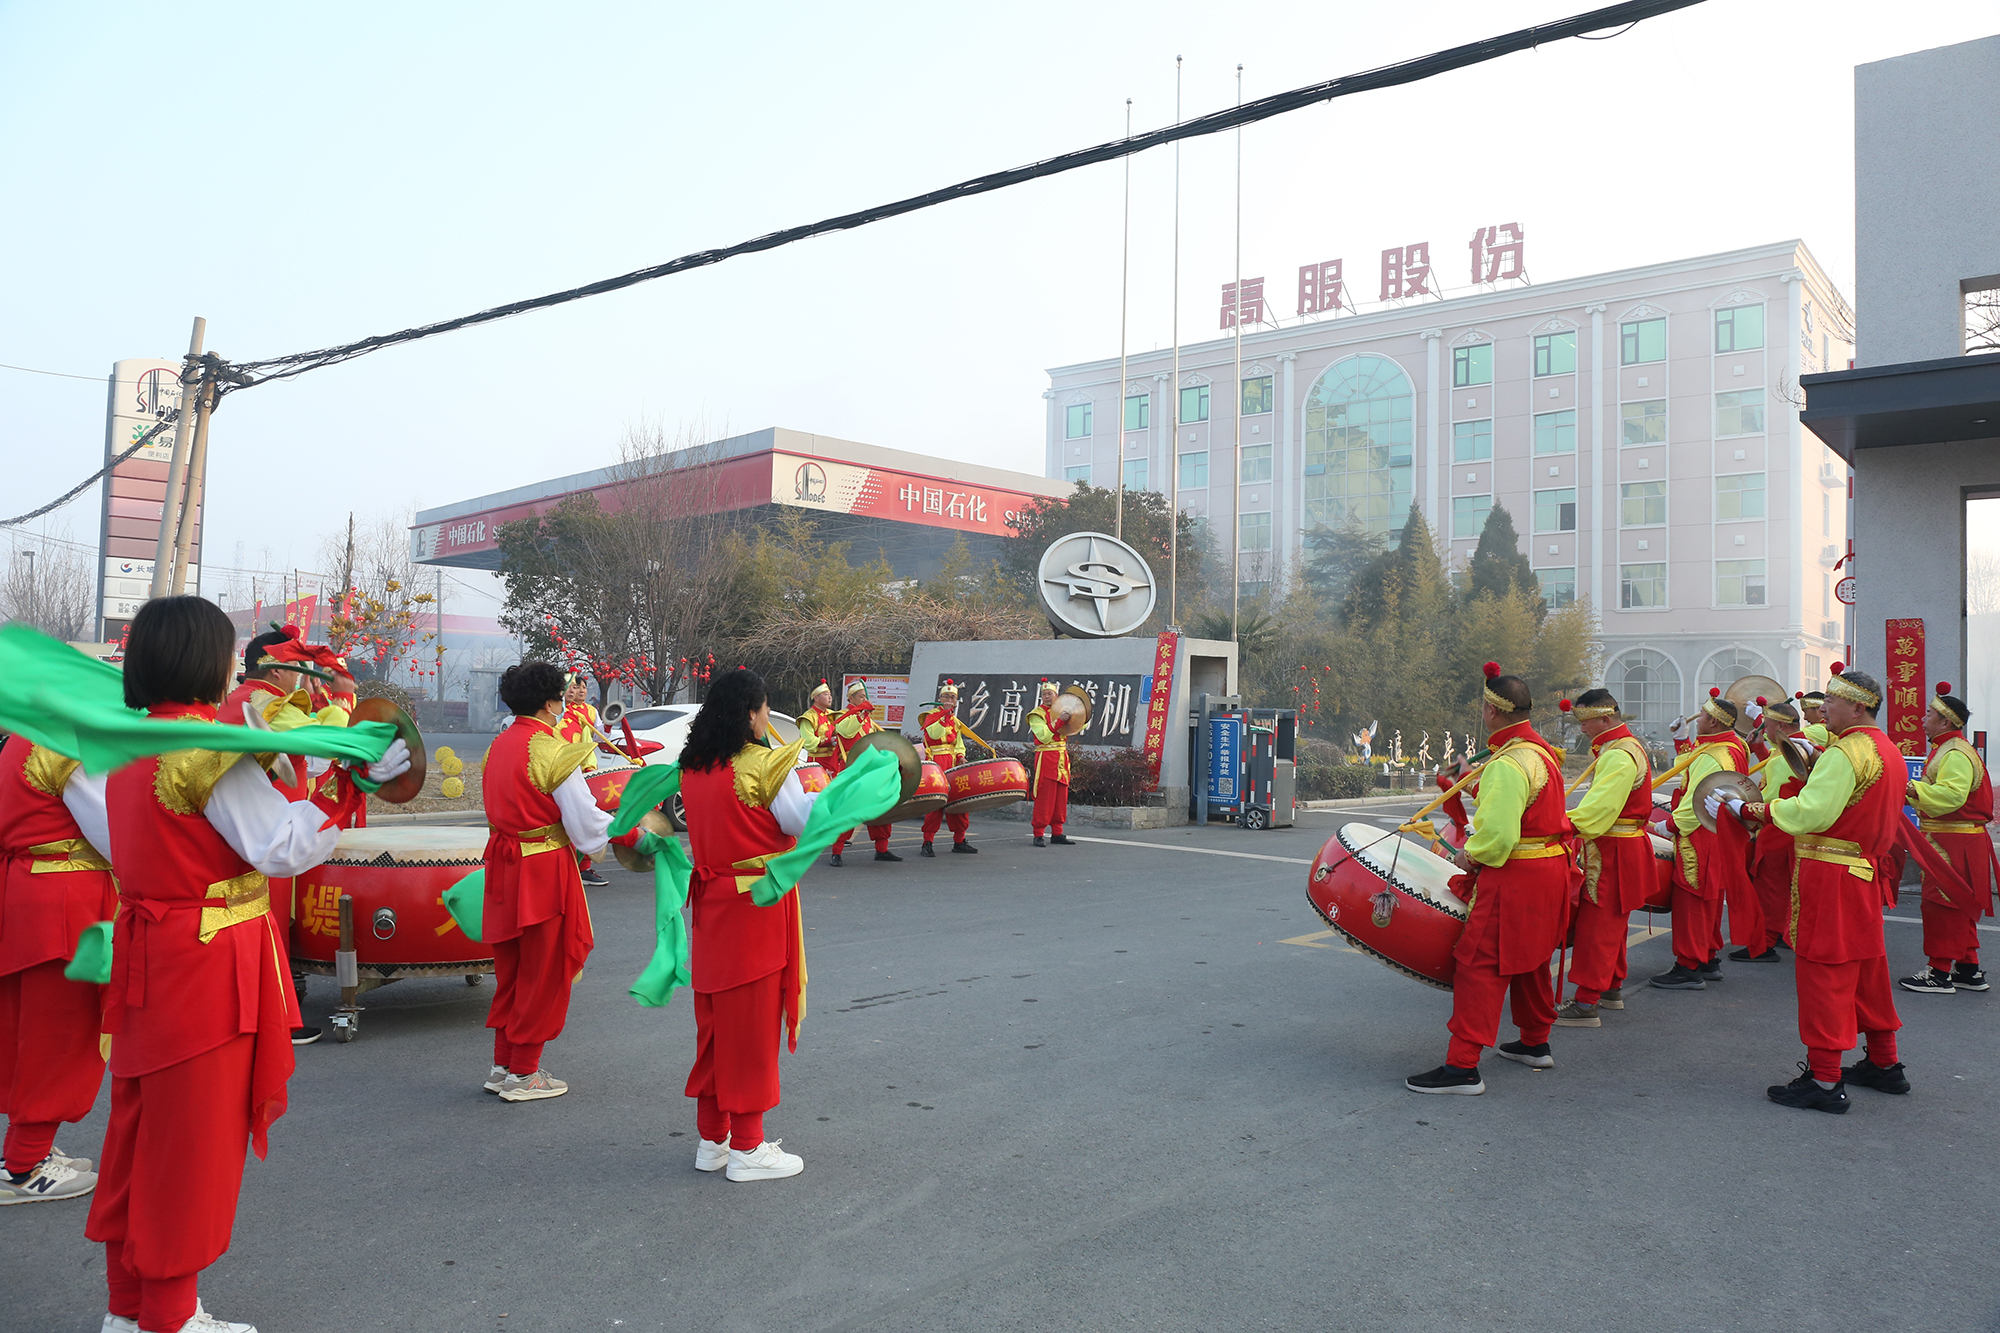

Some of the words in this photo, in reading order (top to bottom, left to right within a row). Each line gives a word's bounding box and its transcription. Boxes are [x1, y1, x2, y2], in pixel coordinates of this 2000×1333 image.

[1220, 222, 1524, 329] 高服股份
[899, 483, 988, 522] 中国石化
[448, 520, 486, 547] 中国石化
[938, 679, 1132, 737] 乡高机
[1220, 723, 1231, 775] 安全生产举报有奖
[1329, 904, 1338, 917] 8
[27, 1176, 57, 1193] N
